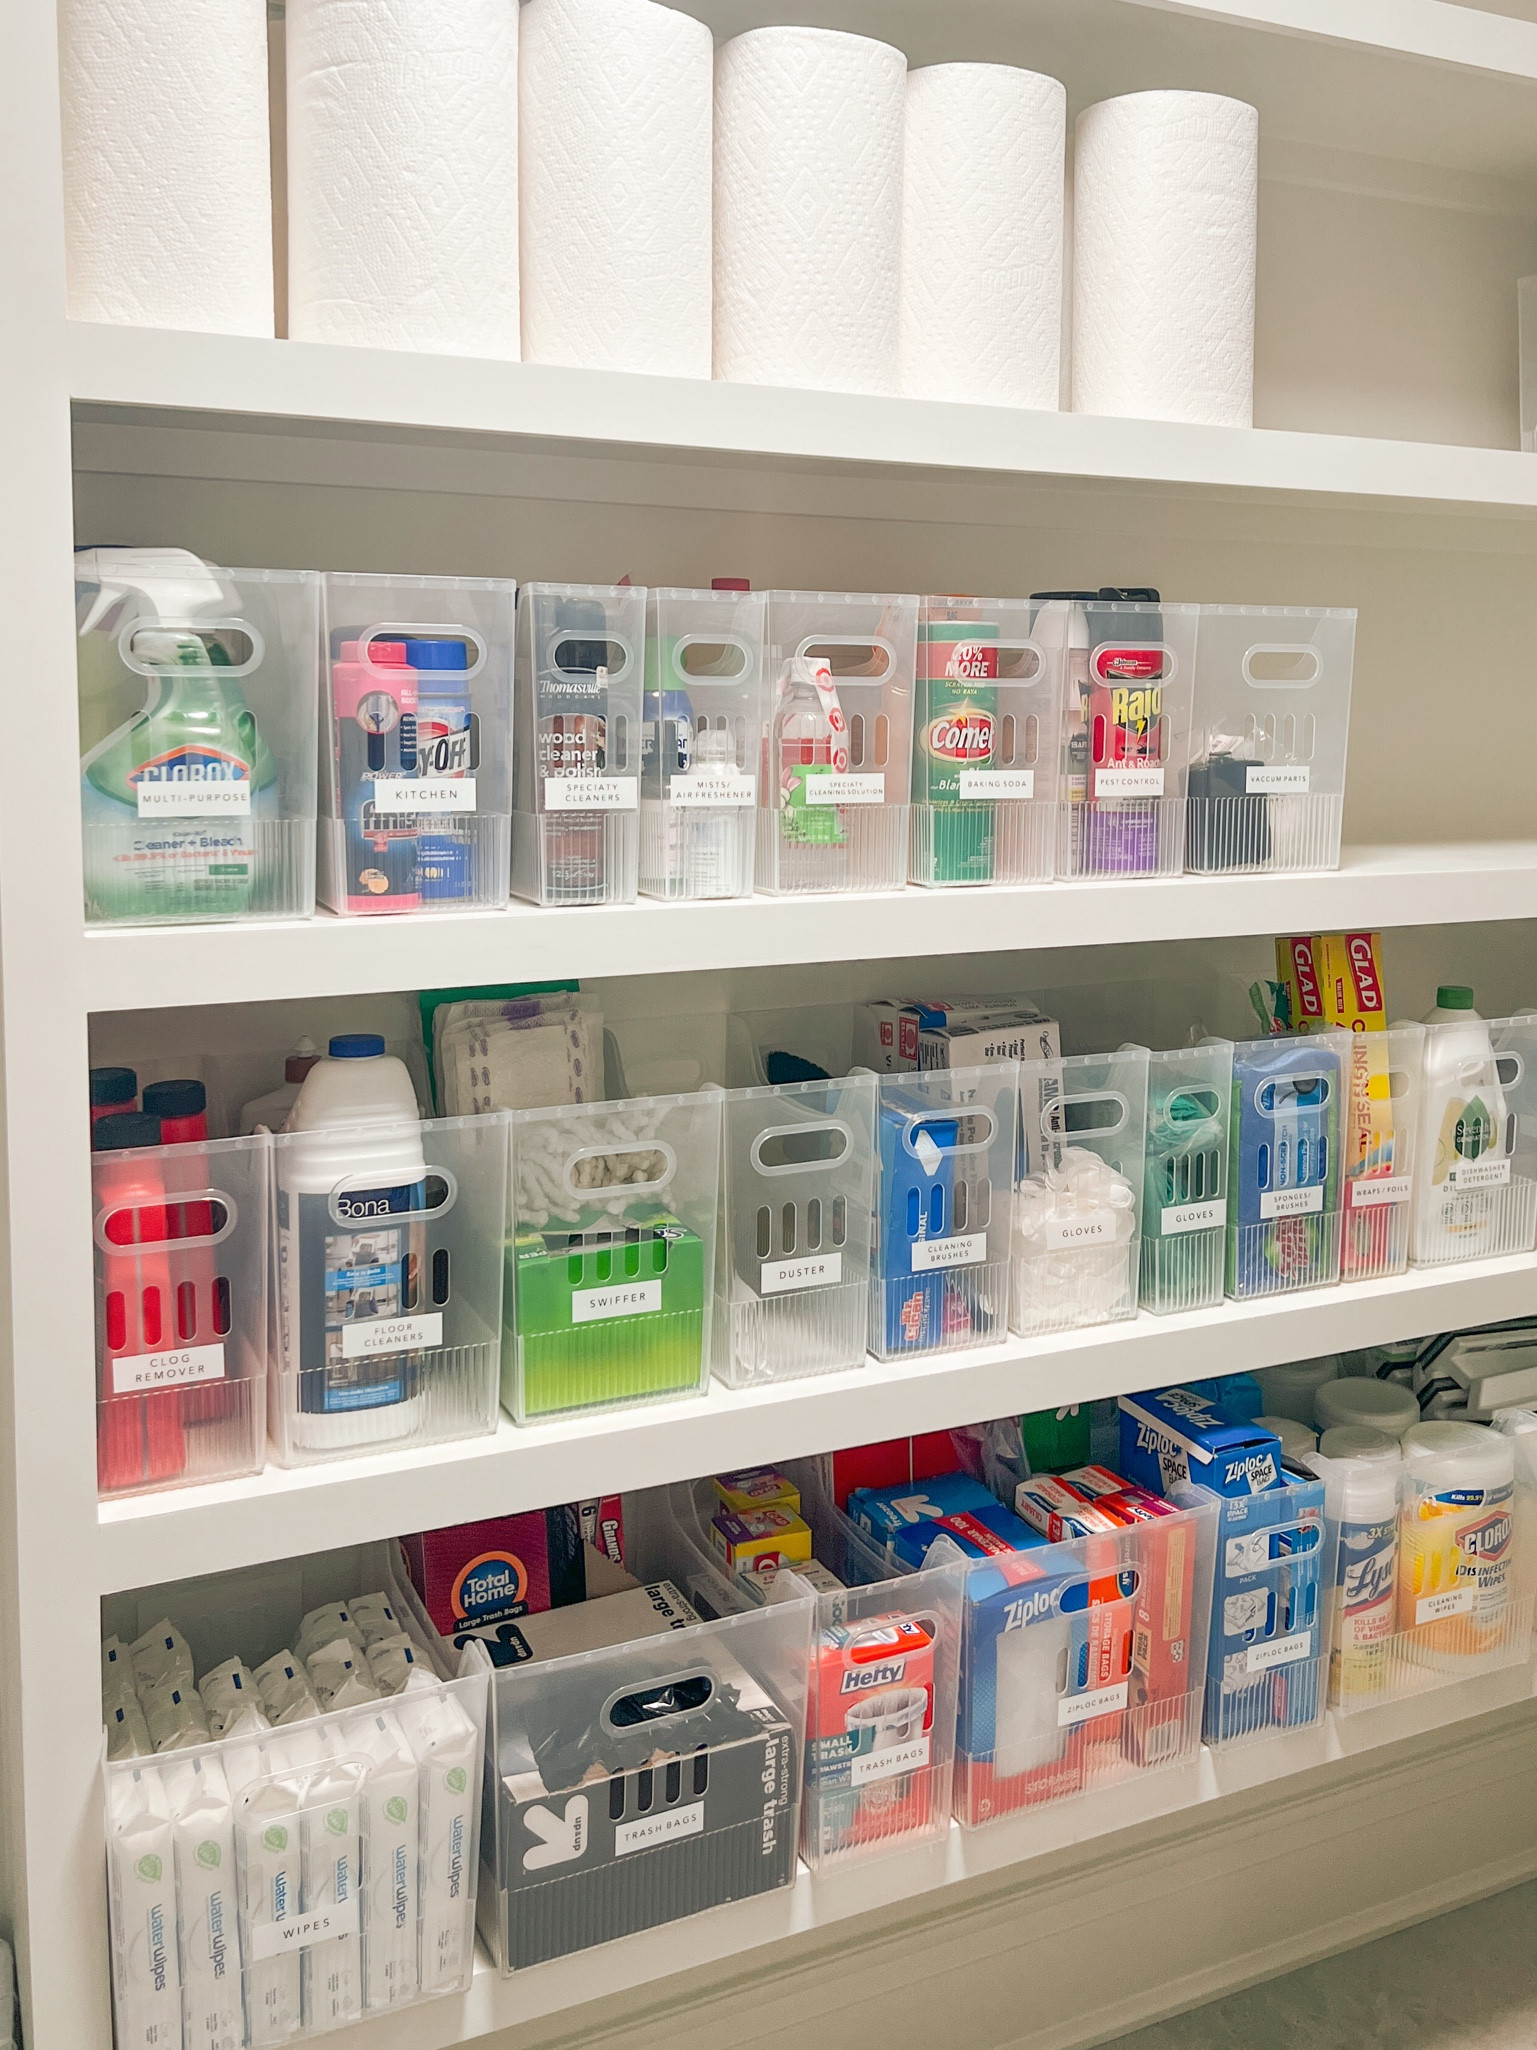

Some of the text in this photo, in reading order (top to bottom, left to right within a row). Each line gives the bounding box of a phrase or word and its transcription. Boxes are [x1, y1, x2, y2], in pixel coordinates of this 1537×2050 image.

[945, 661, 988, 677] MORE
[541, 680, 601, 694] Thomasville
[1112, 683, 1162, 725] Raid
[539, 729, 586, 744] wood
[932, 721, 996, 749] Comet
[539, 745, 598, 761] cleaner
[1107, 758, 1127, 769] Ant
[1128, 760, 1135, 769] &
[696, 781, 731, 789] MISTS/
[967, 780, 1001, 788] BAKING
[1100, 777, 1161, 786] PEST CONTROL
[1250, 775, 1282, 783] VACCUM
[395, 790, 458, 800] KITCHEN
[566, 783, 618, 792] SPECIATY
[675, 791, 753, 799] AIR FRESHENER
[142, 793, 248, 803] MULTI-PURPOSE
[565, 793, 620, 803] CLEANERS
[1294, 942, 1320, 1014] GLAD
[1350, 937, 1379, 1009] GLAD
[1355, 1101, 1373, 1152] SEAL
[1456, 1121, 1490, 1136] Seventh
[1279, 1124, 1288, 1186] NON-SCRATCH
[1461, 1164, 1506, 1176] DISHWASHER
[1463, 1172, 1503, 1184] DETERGENT
[1273, 1192, 1312, 1203] SPONGES/
[1356, 1187, 1381, 1197] WRAPS
[1387, 1184, 1409, 1194] FOILS
[337, 1198, 391, 1219] Bona
[1275, 1200, 1309, 1211] BRUSHES
[1176, 1210, 1214, 1223] GLOVES
[1062, 1224, 1103, 1238] GLOVES
[927, 1240, 973, 1254] CLEANING
[930, 1249, 969, 1262] BRUSHES
[779, 1264, 825, 1280] DUSTER
[589, 1291, 647, 1309] SWIFFER
[374, 1322, 413, 1336] FLOOR
[364, 1331, 424, 1348] CLEANERS
[149, 1353, 191, 1368] CLOG
[135, 1363, 206, 1383] REMOVER
[1136, 1422, 1178, 1458] Ziploc
[1162, 1457, 1187, 1479] SPACE
[1225, 1454, 1264, 1484] Ziploc
[1250, 1464, 1273, 1482] SPACE
[1451, 1493, 1466, 1501] Kills
[581, 1505, 597, 1518] 6
[467, 1569, 510, 1593] Total
[1478, 1573, 1506, 1589] WIPES
[464, 1583, 516, 1608] Home
[644, 1584, 675, 1617] large
[662, 1581, 698, 1622] extra-strong
[1428, 1593, 1464, 1608] CLEANING
[1003, 1586, 1061, 1633] Ziploc
[1434, 1602, 1456, 1614] WIPES
[458, 1604, 524, 1629] Large Trash Bags
[1354, 1617, 1377, 1627] KILLS
[1354, 1625, 1366, 1633] OF
[1100, 1612, 1113, 1678] STORAGE BAGS
[1255, 1642, 1304, 1661] ZIPLOC BAGS
[844, 1664, 902, 1690] Hefty
[1067, 1692, 1121, 1714] ZIPLOC BAGS
[858, 1748, 925, 1774] TRASH BAGS
[778, 1734, 790, 1806] extra-strong
[761, 1734, 780, 1856] large trash
[624, 1813, 698, 1842] TRASH BAGS
[282, 1917, 331, 1940] WIPES
